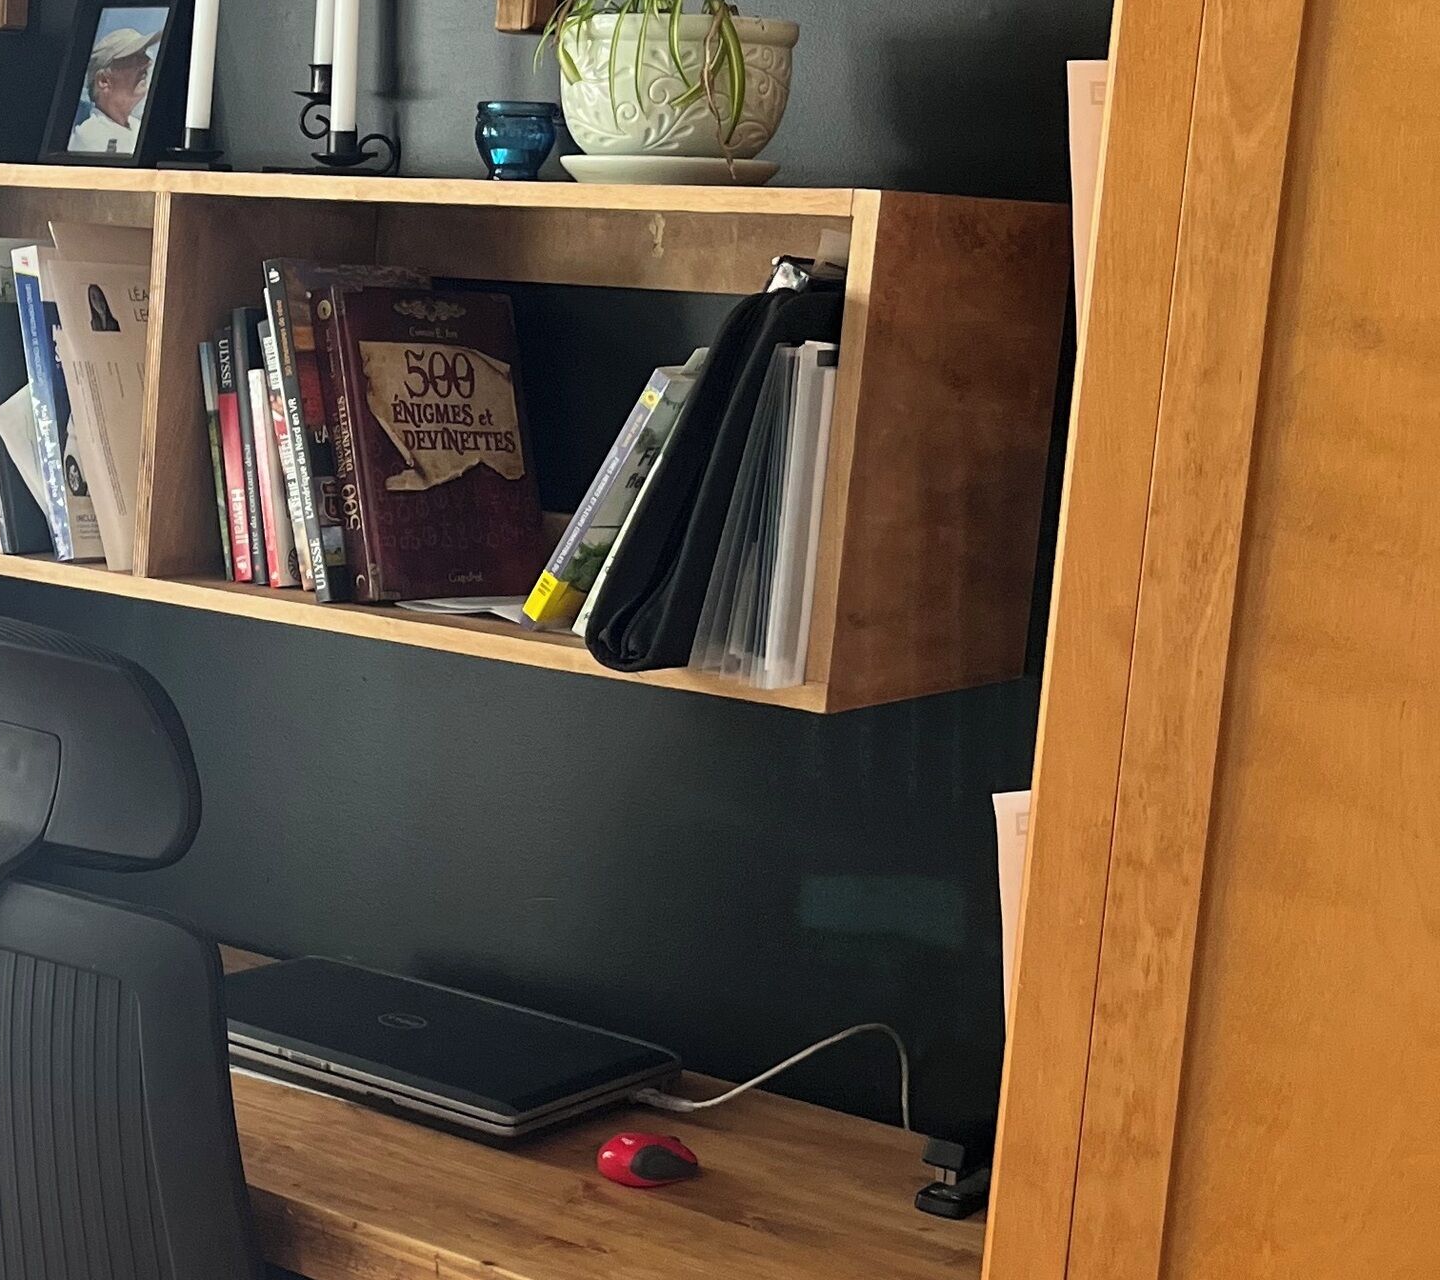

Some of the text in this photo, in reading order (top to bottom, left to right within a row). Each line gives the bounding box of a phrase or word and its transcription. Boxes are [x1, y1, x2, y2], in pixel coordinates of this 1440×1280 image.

[218, 338, 232, 388] ULYSSE
[403, 349, 475, 399] 500
[337, 396, 353, 471] DEVINETTES
[391, 394, 494, 428] ÉNIGMES et
[288, 398, 315, 519] L'Amérique du Nord en VR
[402, 427, 516, 456] DEVINETTES
[246, 471, 257, 513] constant
[342, 484, 361, 530] 500
[250, 516, 258, 529] du
[252, 532, 260, 555] Livre
[310, 538, 327, 590] ULYSSE
